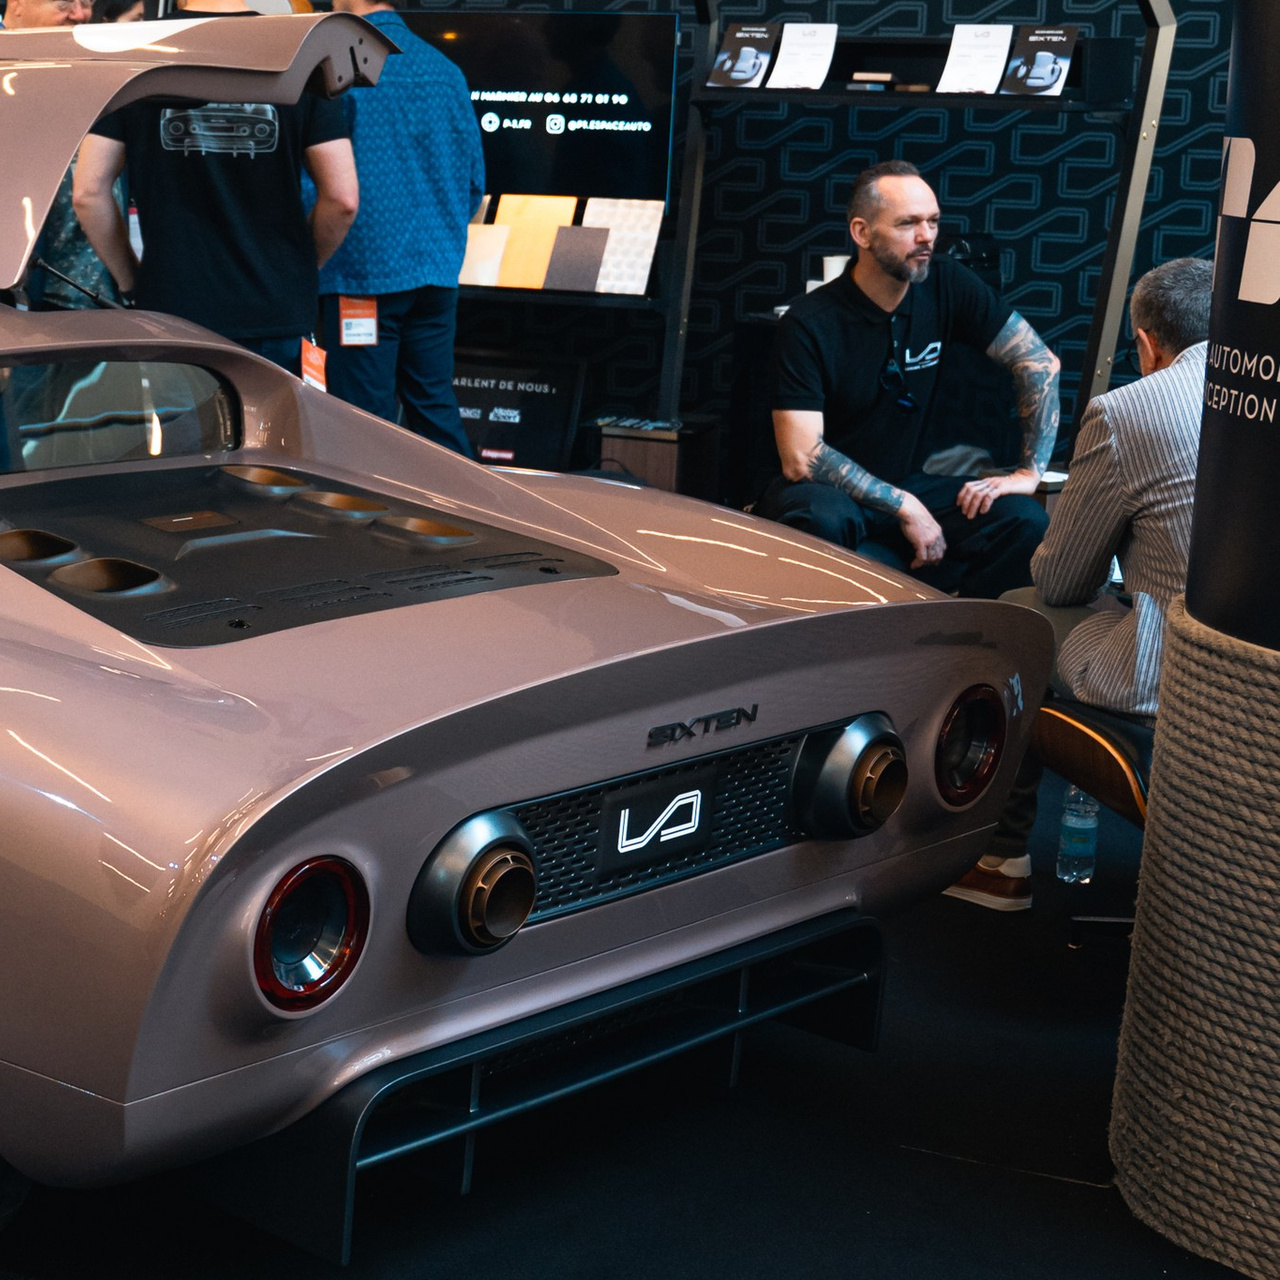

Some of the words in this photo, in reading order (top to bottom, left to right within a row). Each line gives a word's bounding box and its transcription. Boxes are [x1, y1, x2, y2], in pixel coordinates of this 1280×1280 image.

[1209, 343, 1280, 382] AUTOMO
[452, 376, 496, 389] ARLENT
[499, 380, 515, 391] DE
[517, 381, 551, 394] NOUS
[646, 703, 759, 747] SIXTEN
